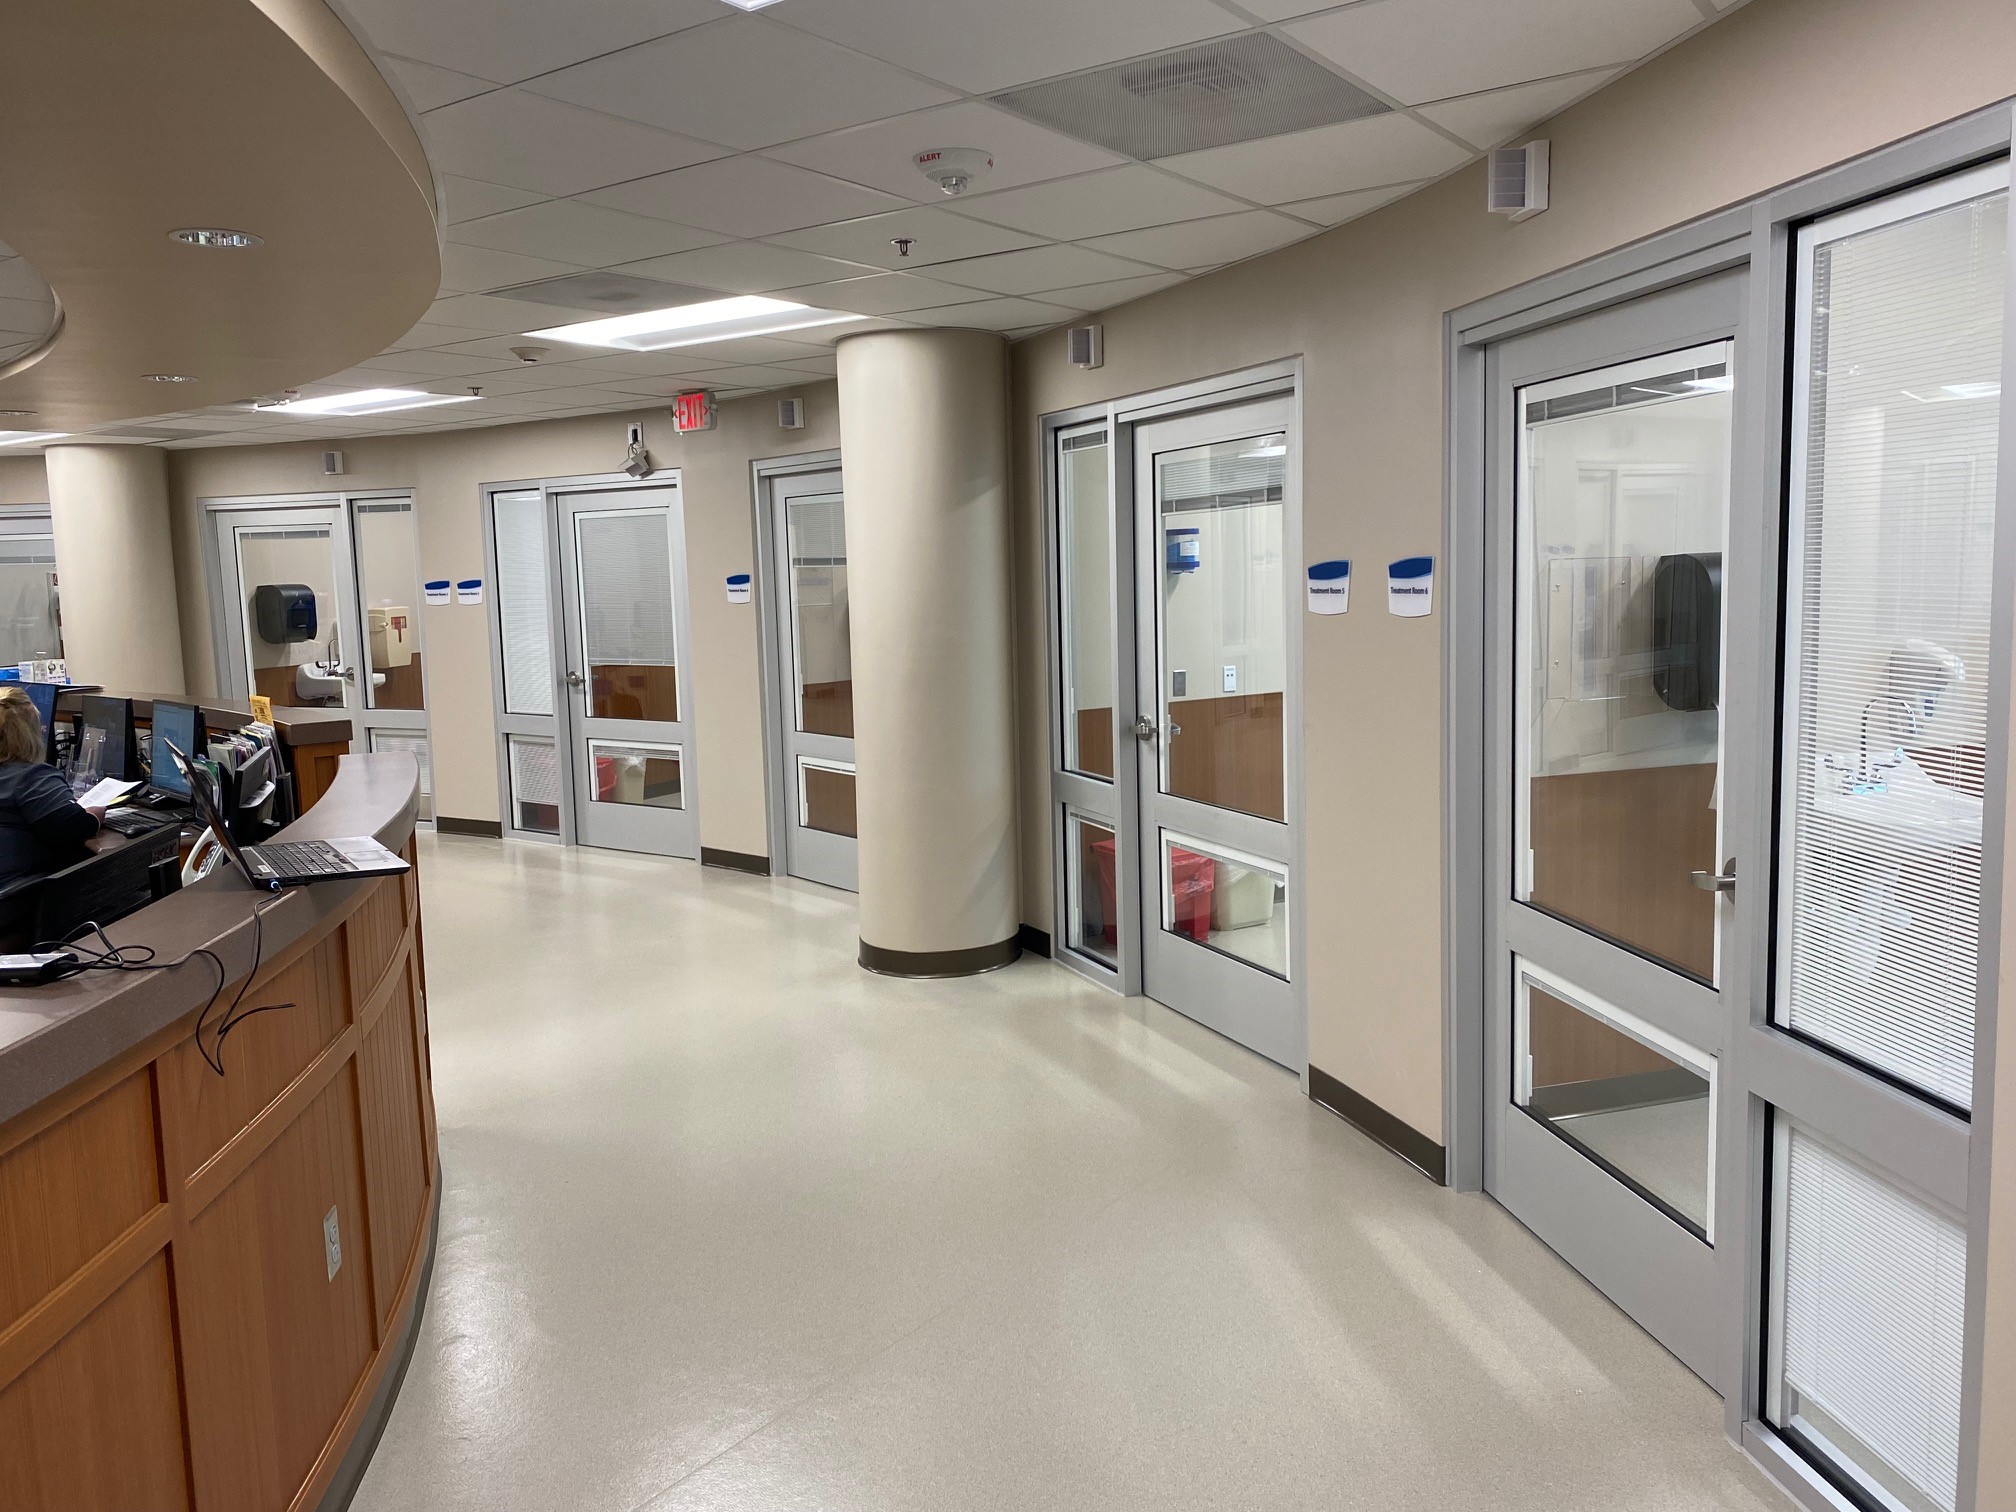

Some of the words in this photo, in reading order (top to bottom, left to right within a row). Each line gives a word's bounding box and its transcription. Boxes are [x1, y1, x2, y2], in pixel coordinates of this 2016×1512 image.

[919, 152, 941, 163] ALERT
[678, 393, 704, 430] EXIT
[1390, 586, 1411, 594] Treatment
[1412, 586, 1424, 594] Room
